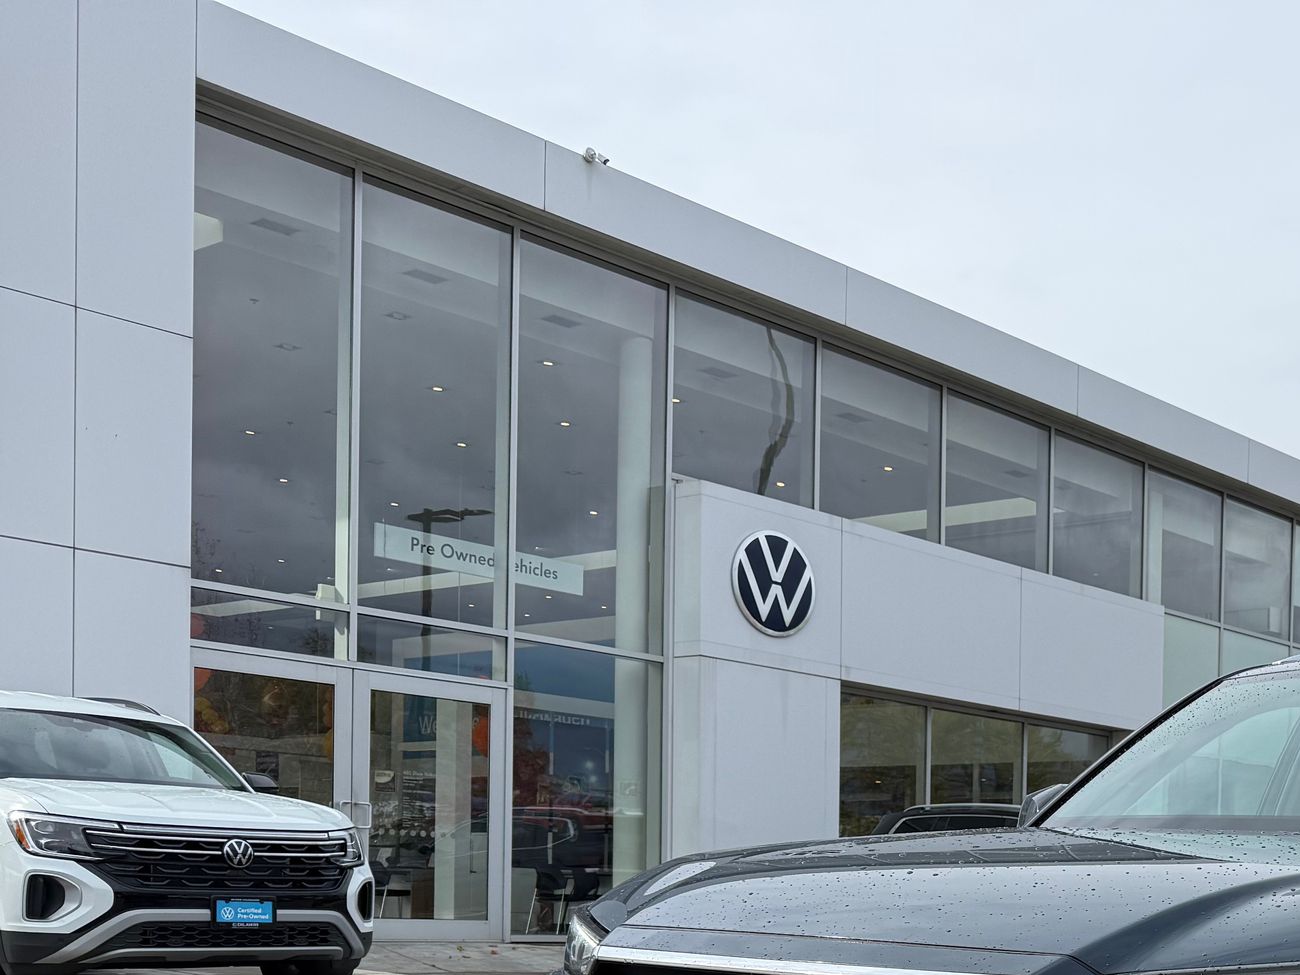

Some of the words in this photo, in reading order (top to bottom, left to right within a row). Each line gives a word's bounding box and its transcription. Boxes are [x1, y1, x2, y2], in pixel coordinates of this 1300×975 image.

[411, 537, 435, 556] Pre
[441, 544, 495, 567] Owned
[514, 557, 559, 580] ehicles
[732, 530, 815, 637] VW
[224, 839, 253, 868] VW
